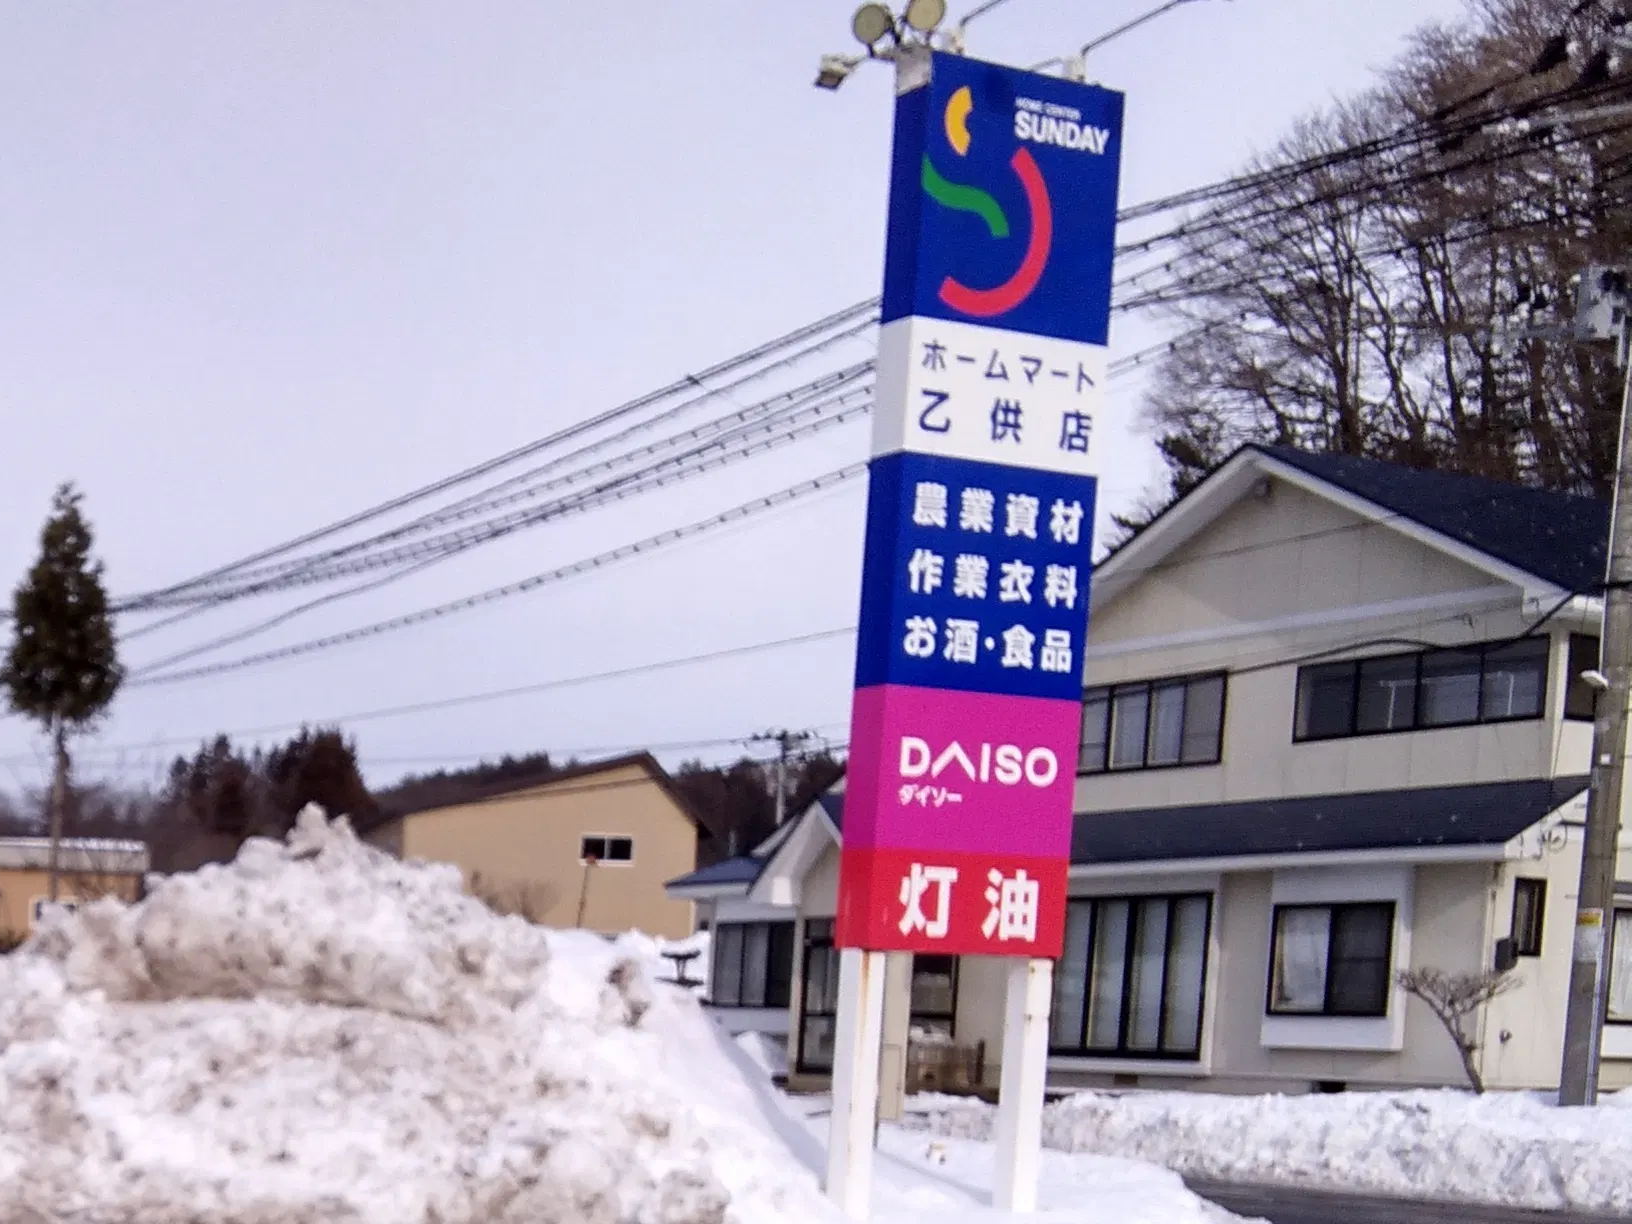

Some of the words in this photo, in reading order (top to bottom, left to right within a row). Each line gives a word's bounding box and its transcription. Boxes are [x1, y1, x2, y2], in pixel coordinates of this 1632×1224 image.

[1014, 109, 1110, 155] SUNDAY
[921, 337, 1095, 393] ホームマート
[919, 387, 1093, 454] 乙供店
[912, 481, 1084, 544] 農業資材
[908, 548, 1077, 610] 作業衣料
[899, 735, 1058, 787] DAISO
[898, 783, 963, 808] ダイソー
[898, 862, 1041, 943] 灯油
